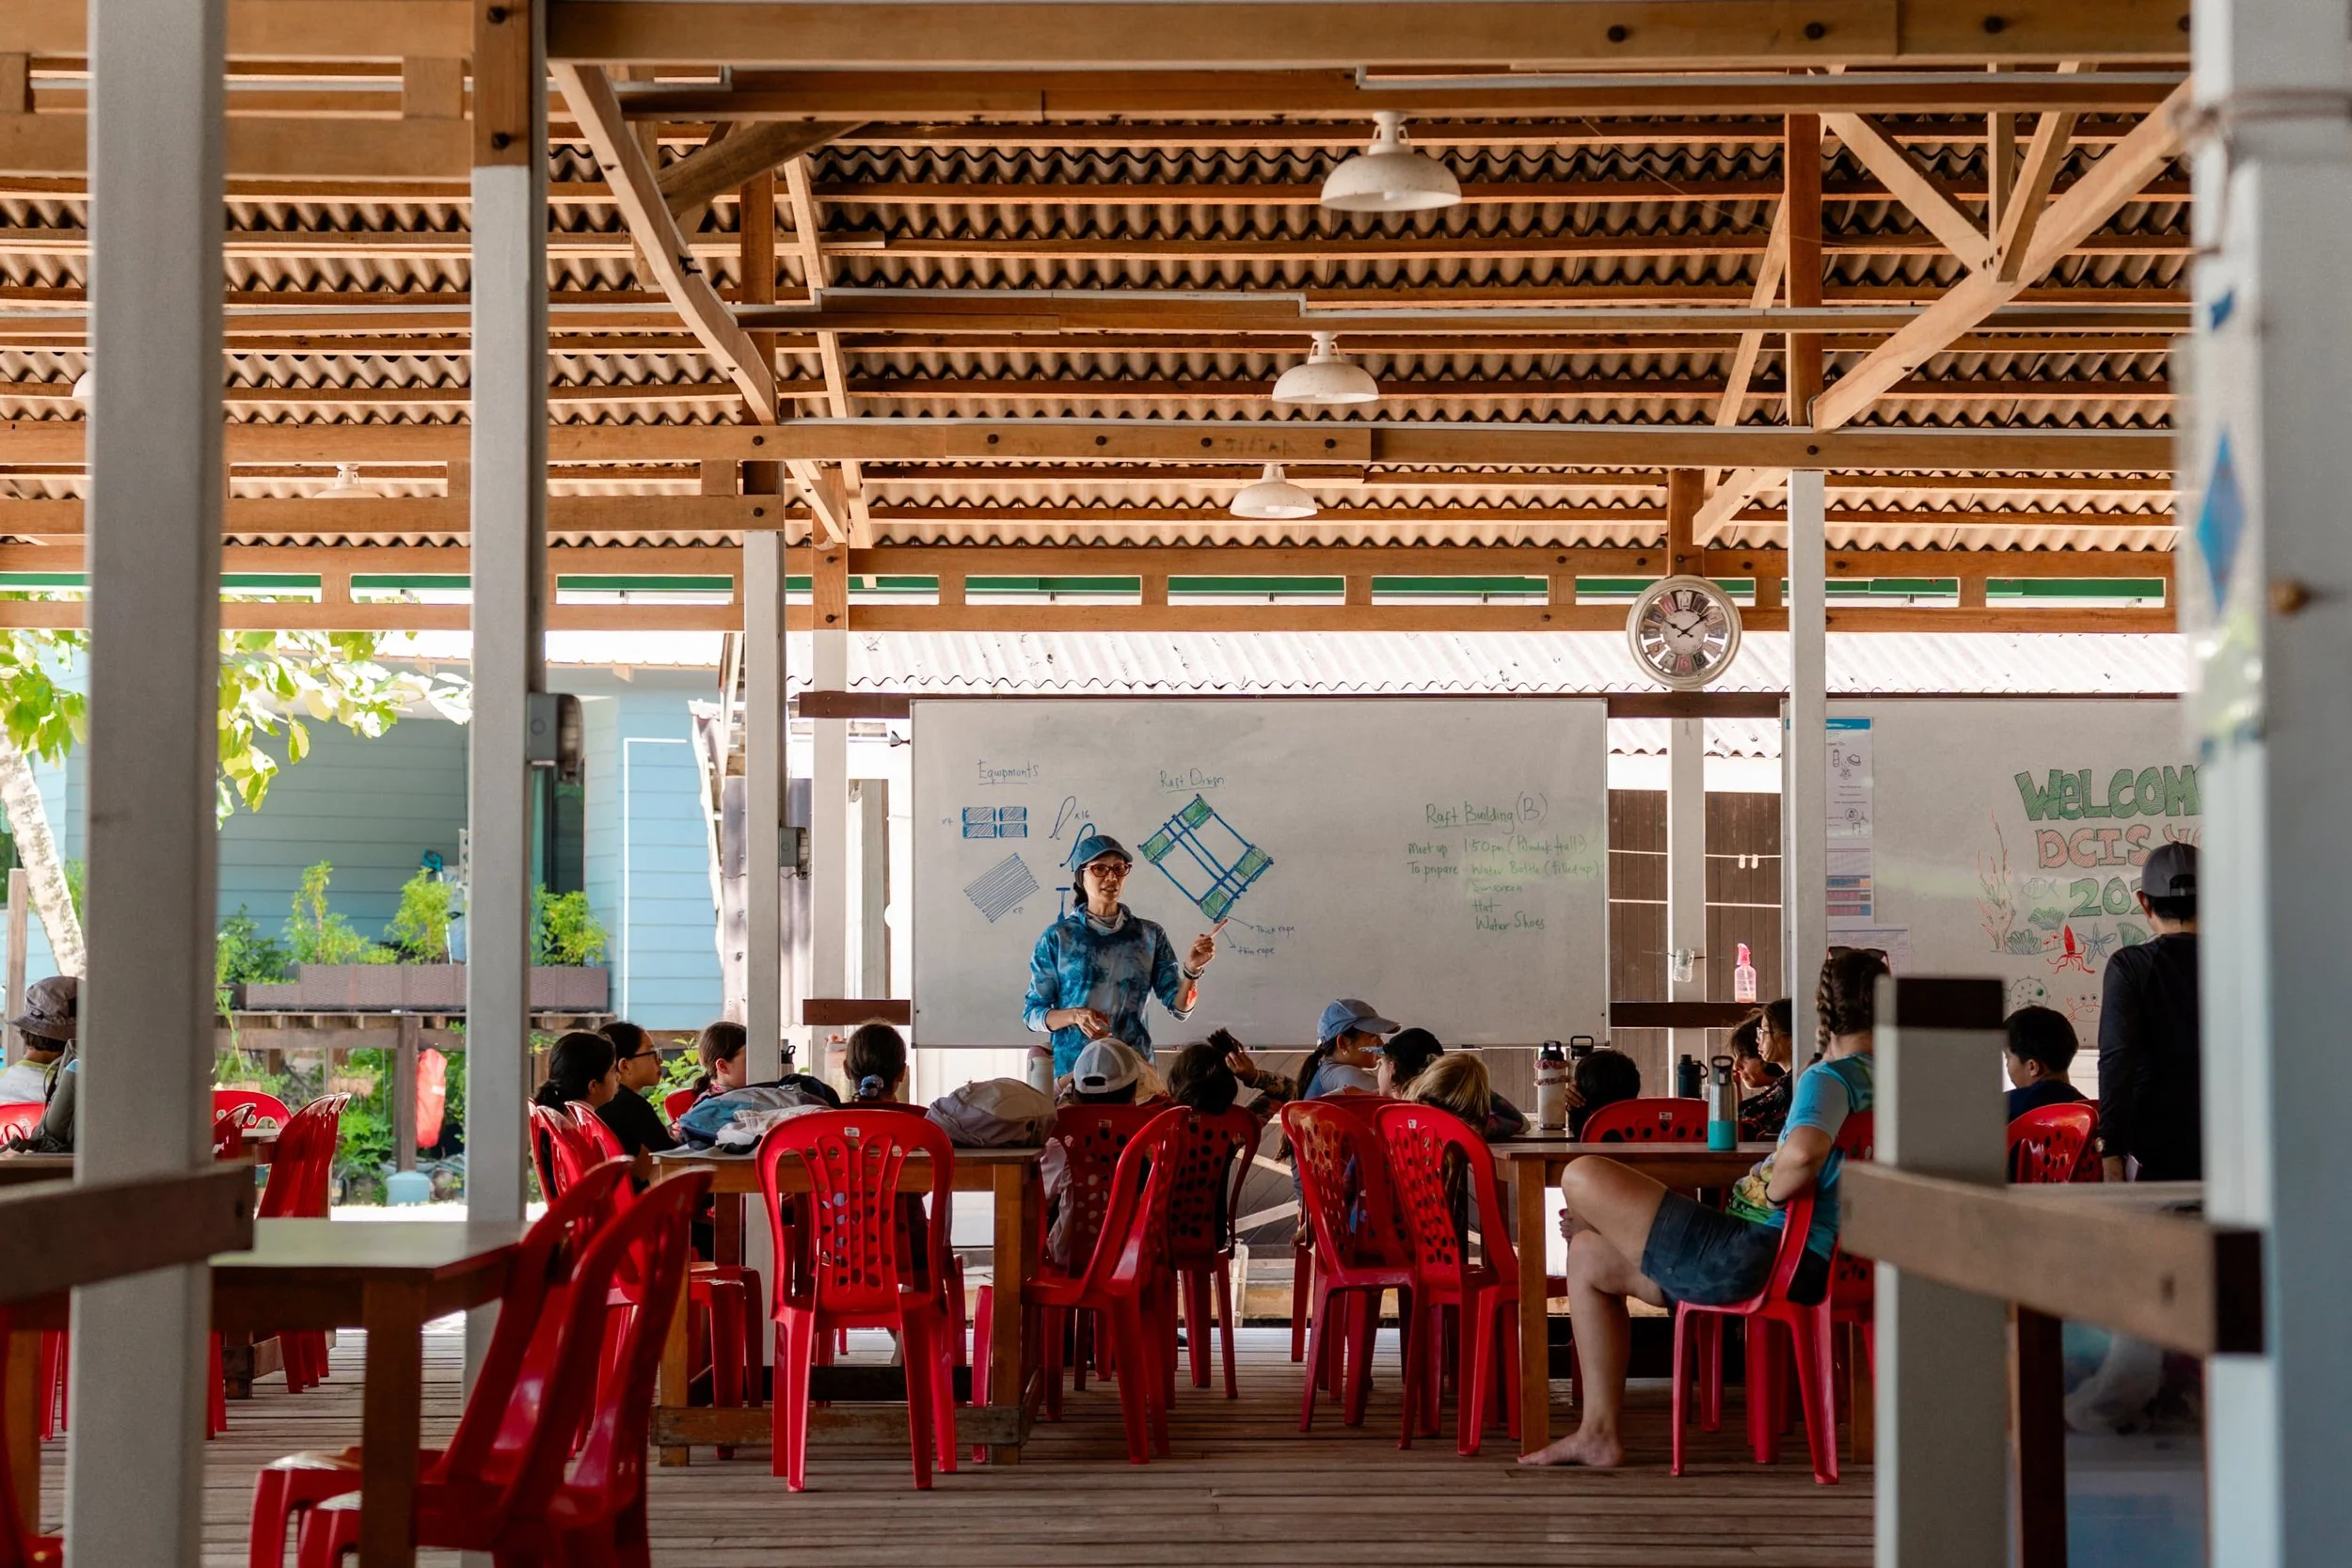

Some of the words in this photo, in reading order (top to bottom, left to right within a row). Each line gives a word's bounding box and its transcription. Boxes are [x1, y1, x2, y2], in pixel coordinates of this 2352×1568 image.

[1425, 802, 1459, 828] Raft
[1464, 800, 1516, 835] Building
[1516, 790, 1549, 827] (B)
[2035, 823, 2153, 869] DCIS
[1406, 860, 1421, 874] To
[1475, 914, 1511, 931] Water
[1513, 909, 1546, 930] Shoes
